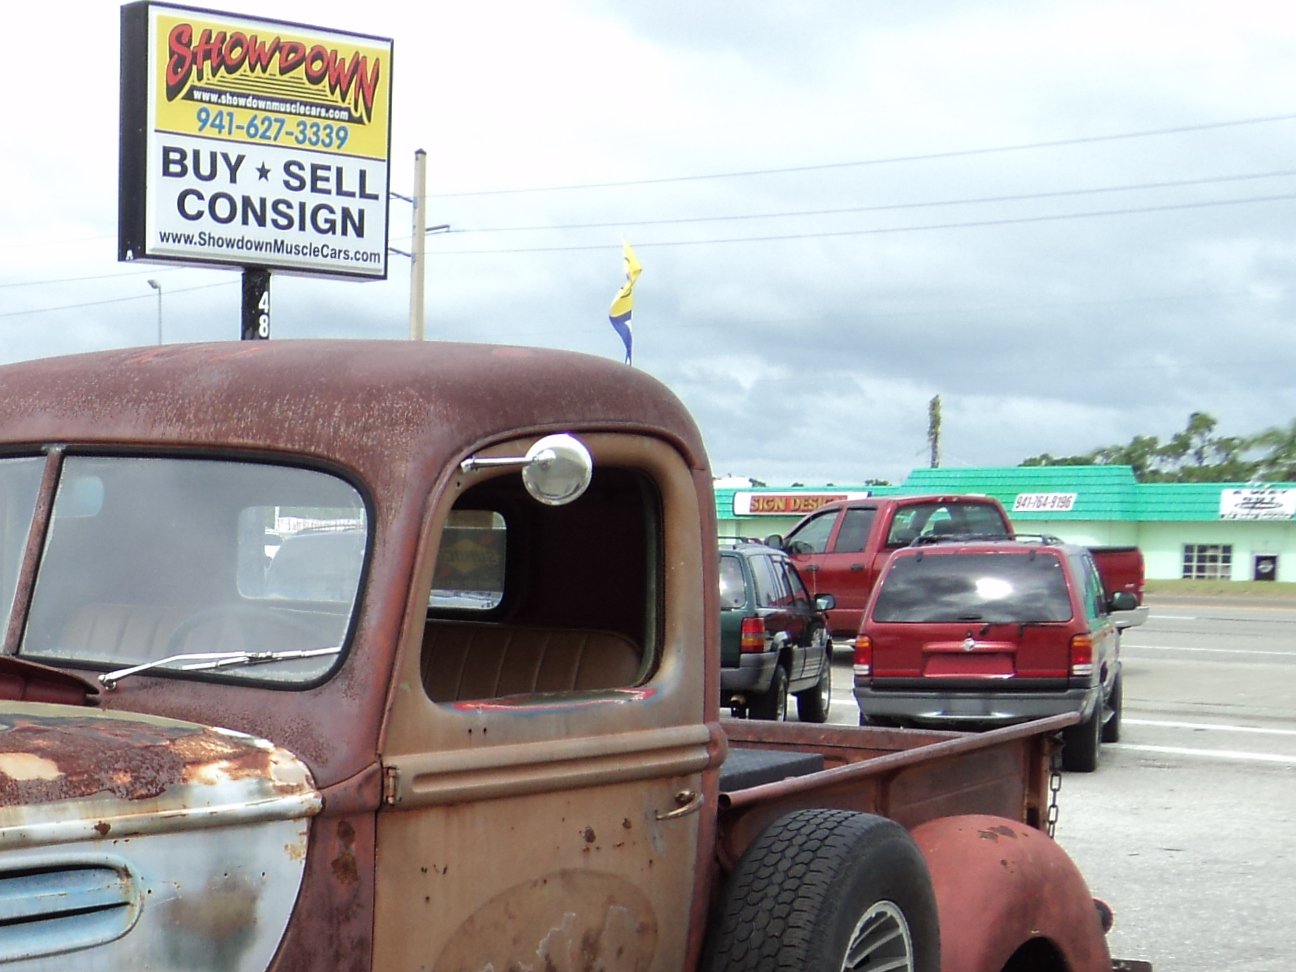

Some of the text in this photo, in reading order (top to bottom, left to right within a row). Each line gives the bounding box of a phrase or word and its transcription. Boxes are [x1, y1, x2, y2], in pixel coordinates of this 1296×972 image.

[166, 23, 380, 123] SHOWDOWN
[193, 89, 349, 121] www.showdownmusclecars.com
[196, 106, 349, 150] 941-627-3339
[161, 145, 380, 201] BUY SELL
[176, 187, 365, 239] CONSIGN
[158, 230, 381, 264] www.ShowdownMuscleCars.com
[750, 499, 785, 512] SIGN
